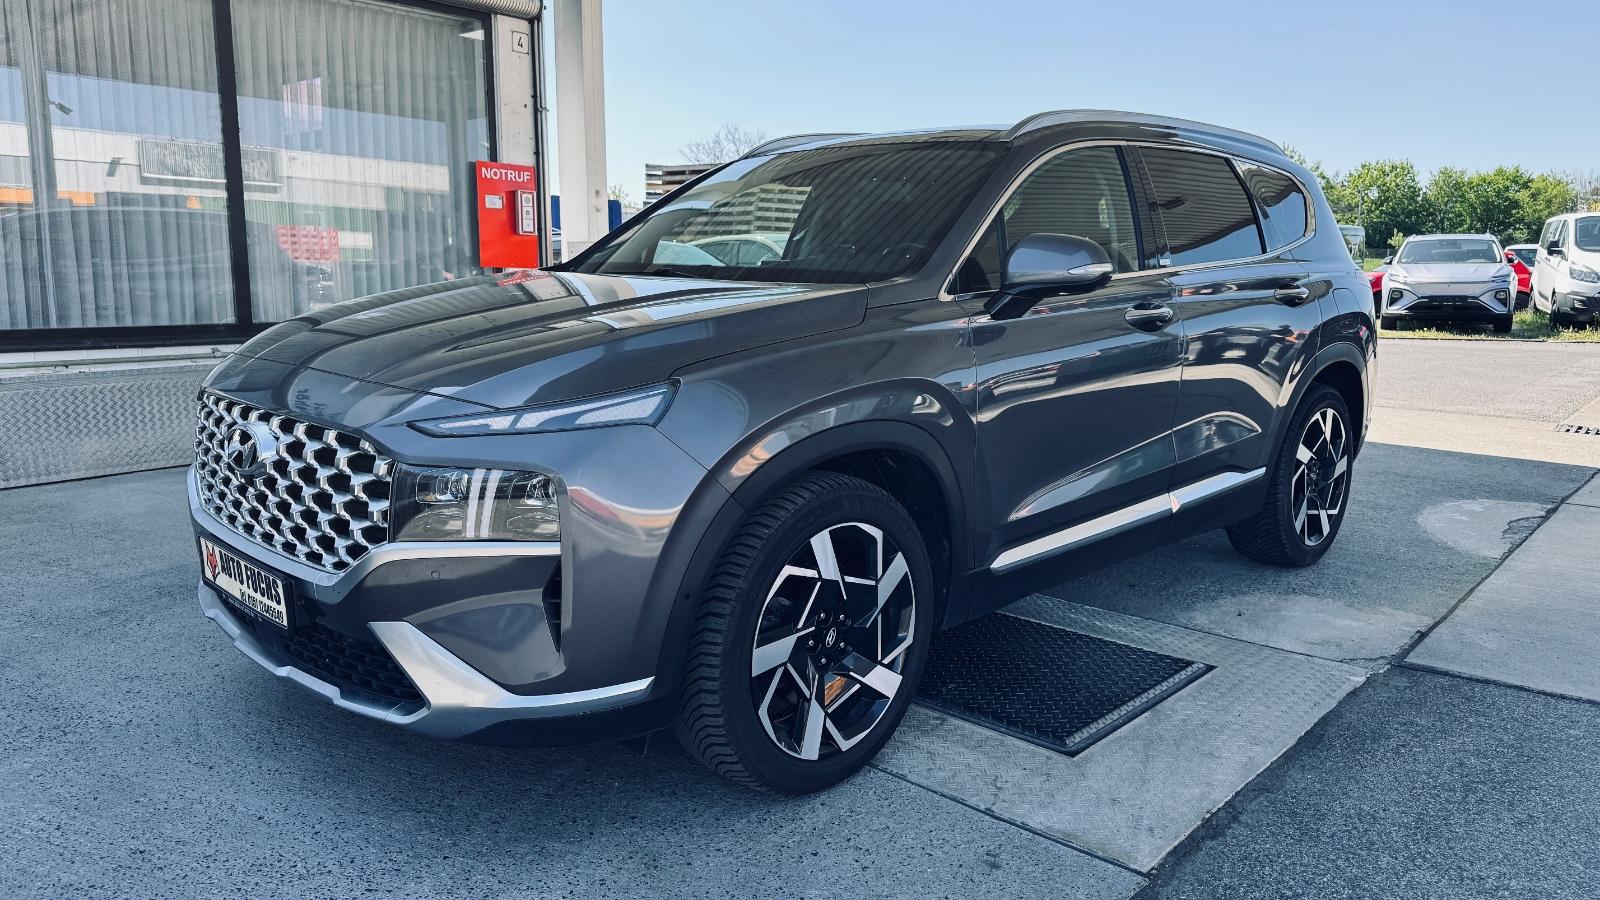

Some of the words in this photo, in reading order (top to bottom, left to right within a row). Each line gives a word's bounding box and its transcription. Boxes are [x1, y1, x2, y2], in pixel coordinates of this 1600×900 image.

[517, 36, 523, 49] 4
[481, 167, 531, 183] NOTRUF
[219, 549, 244, 586] AUTO
[243, 563, 282, 606] FUCHS
